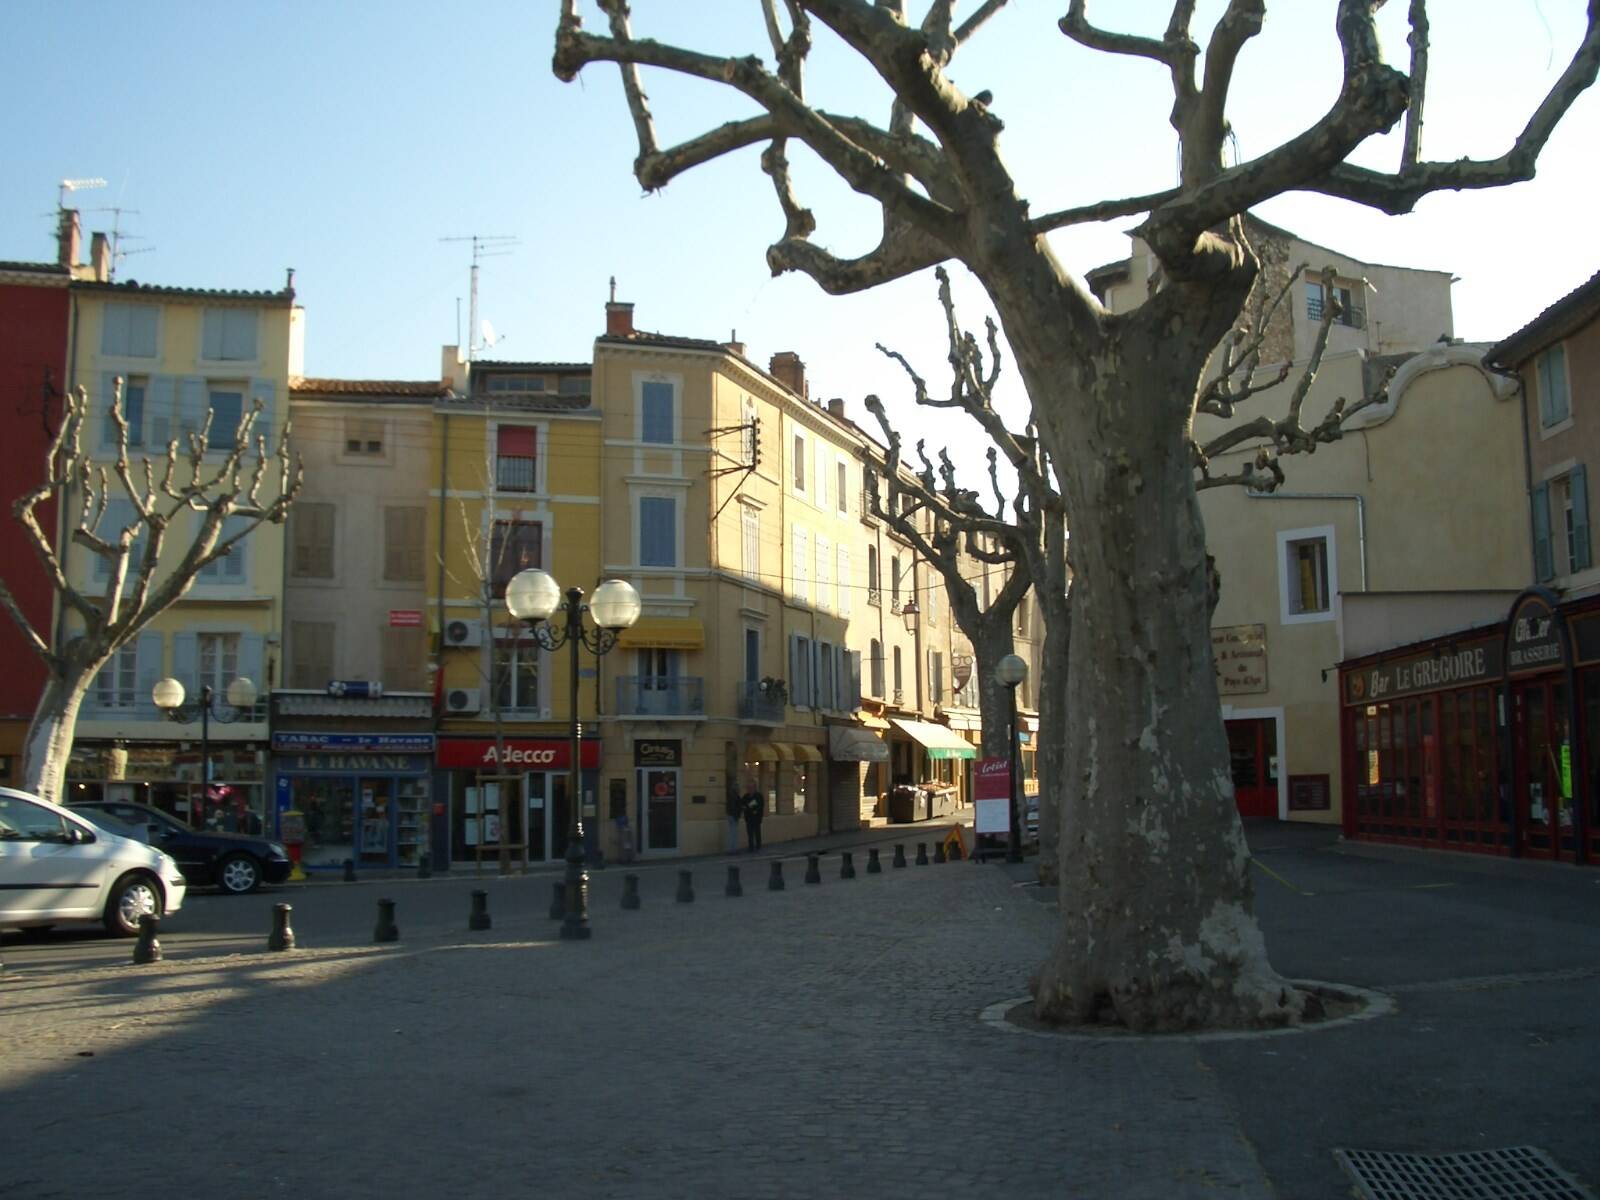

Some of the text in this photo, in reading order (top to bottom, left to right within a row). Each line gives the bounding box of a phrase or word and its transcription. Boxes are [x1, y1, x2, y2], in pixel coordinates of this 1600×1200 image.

[1515, 617, 1551, 643] Glaer
[1510, 642, 1560, 666] BRASSERIE
[1369, 670, 1389, 698] Bar
[279, 735, 330, 743] TABAC
[297, 755, 409, 769] LE HAVANE
[482, 745, 557, 763] Adecco
